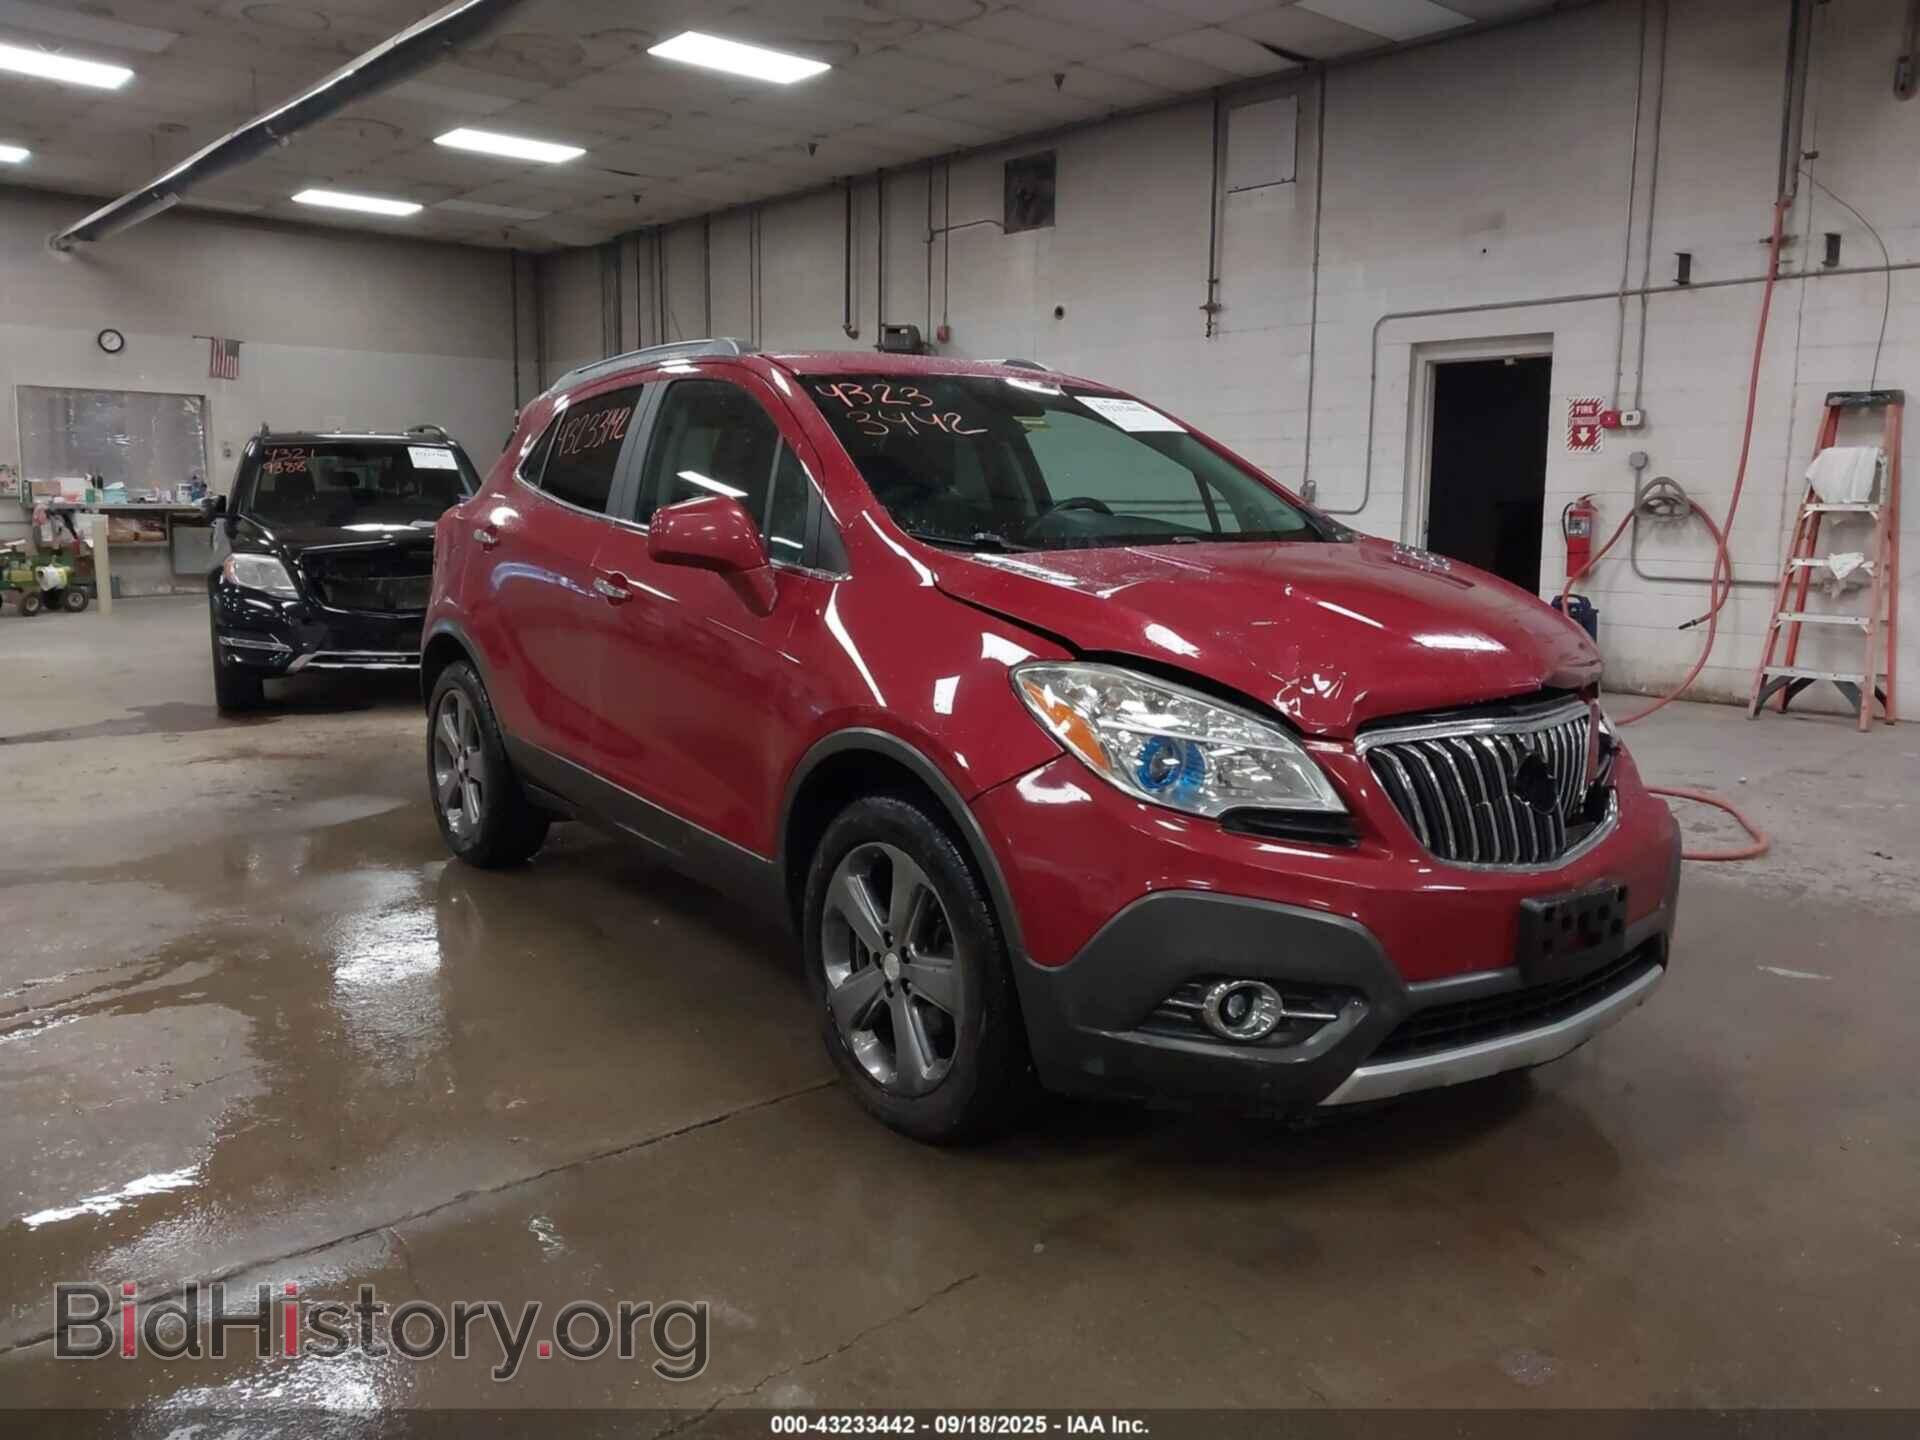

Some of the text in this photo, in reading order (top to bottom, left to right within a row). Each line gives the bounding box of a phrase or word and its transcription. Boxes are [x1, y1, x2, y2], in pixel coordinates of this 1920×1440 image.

[815, 383, 934, 407] 4323
[558, 407, 631, 456] 43233442
[847, 410, 989, 435] 3442
